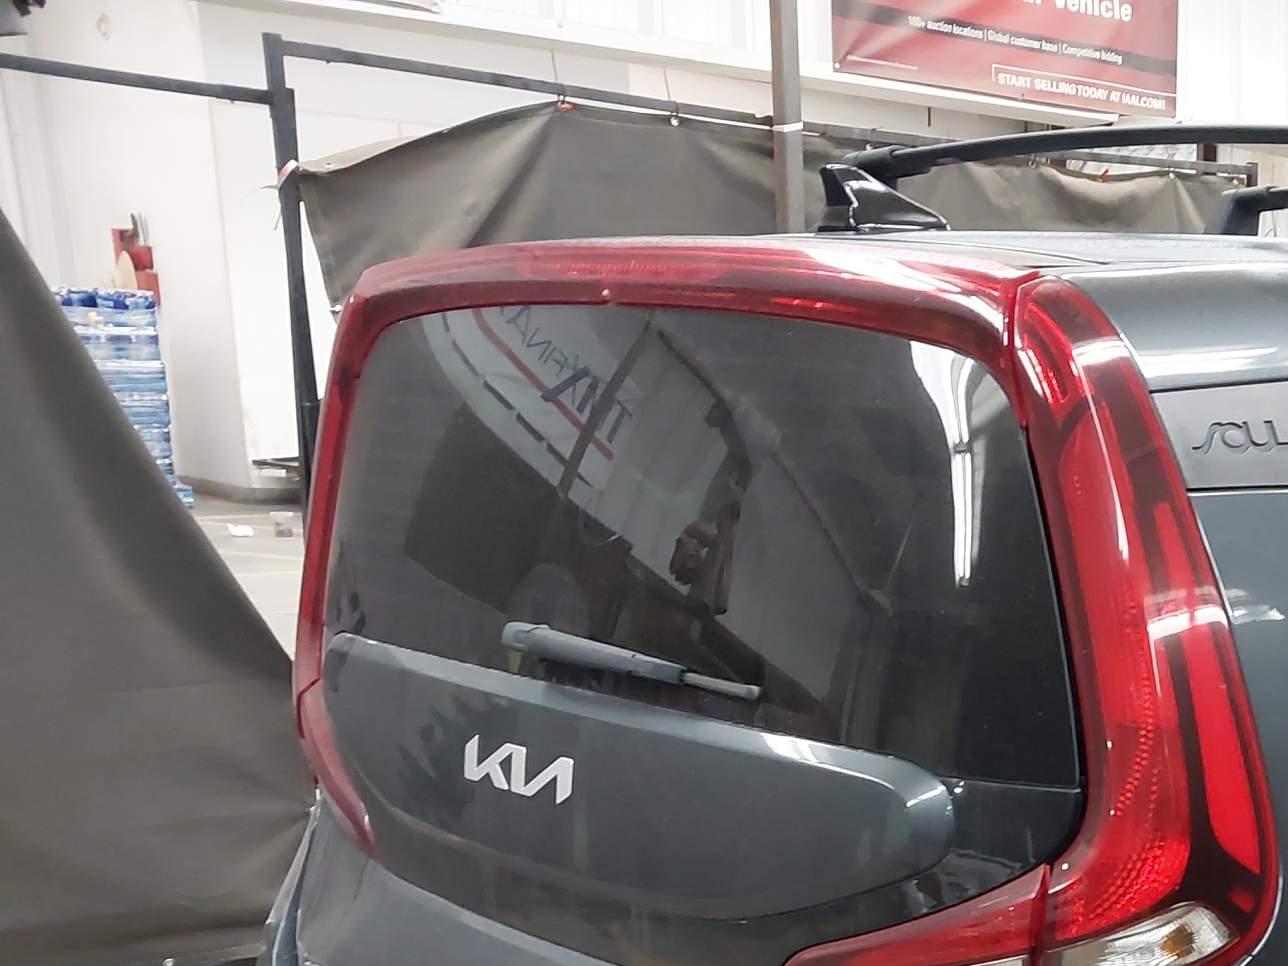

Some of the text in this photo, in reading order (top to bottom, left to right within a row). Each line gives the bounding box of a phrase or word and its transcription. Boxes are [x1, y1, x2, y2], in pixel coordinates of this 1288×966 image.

[926, 20, 953, 33] auction
[952, 23, 983, 39] locations
[998, 72, 1031, 89] START
[1034, 78, 1077, 96] SELLING
[1077, 84, 1110, 101] TODAY
[1109, 90, 1122, 102] AT
[463, 734, 575, 804] KIA
